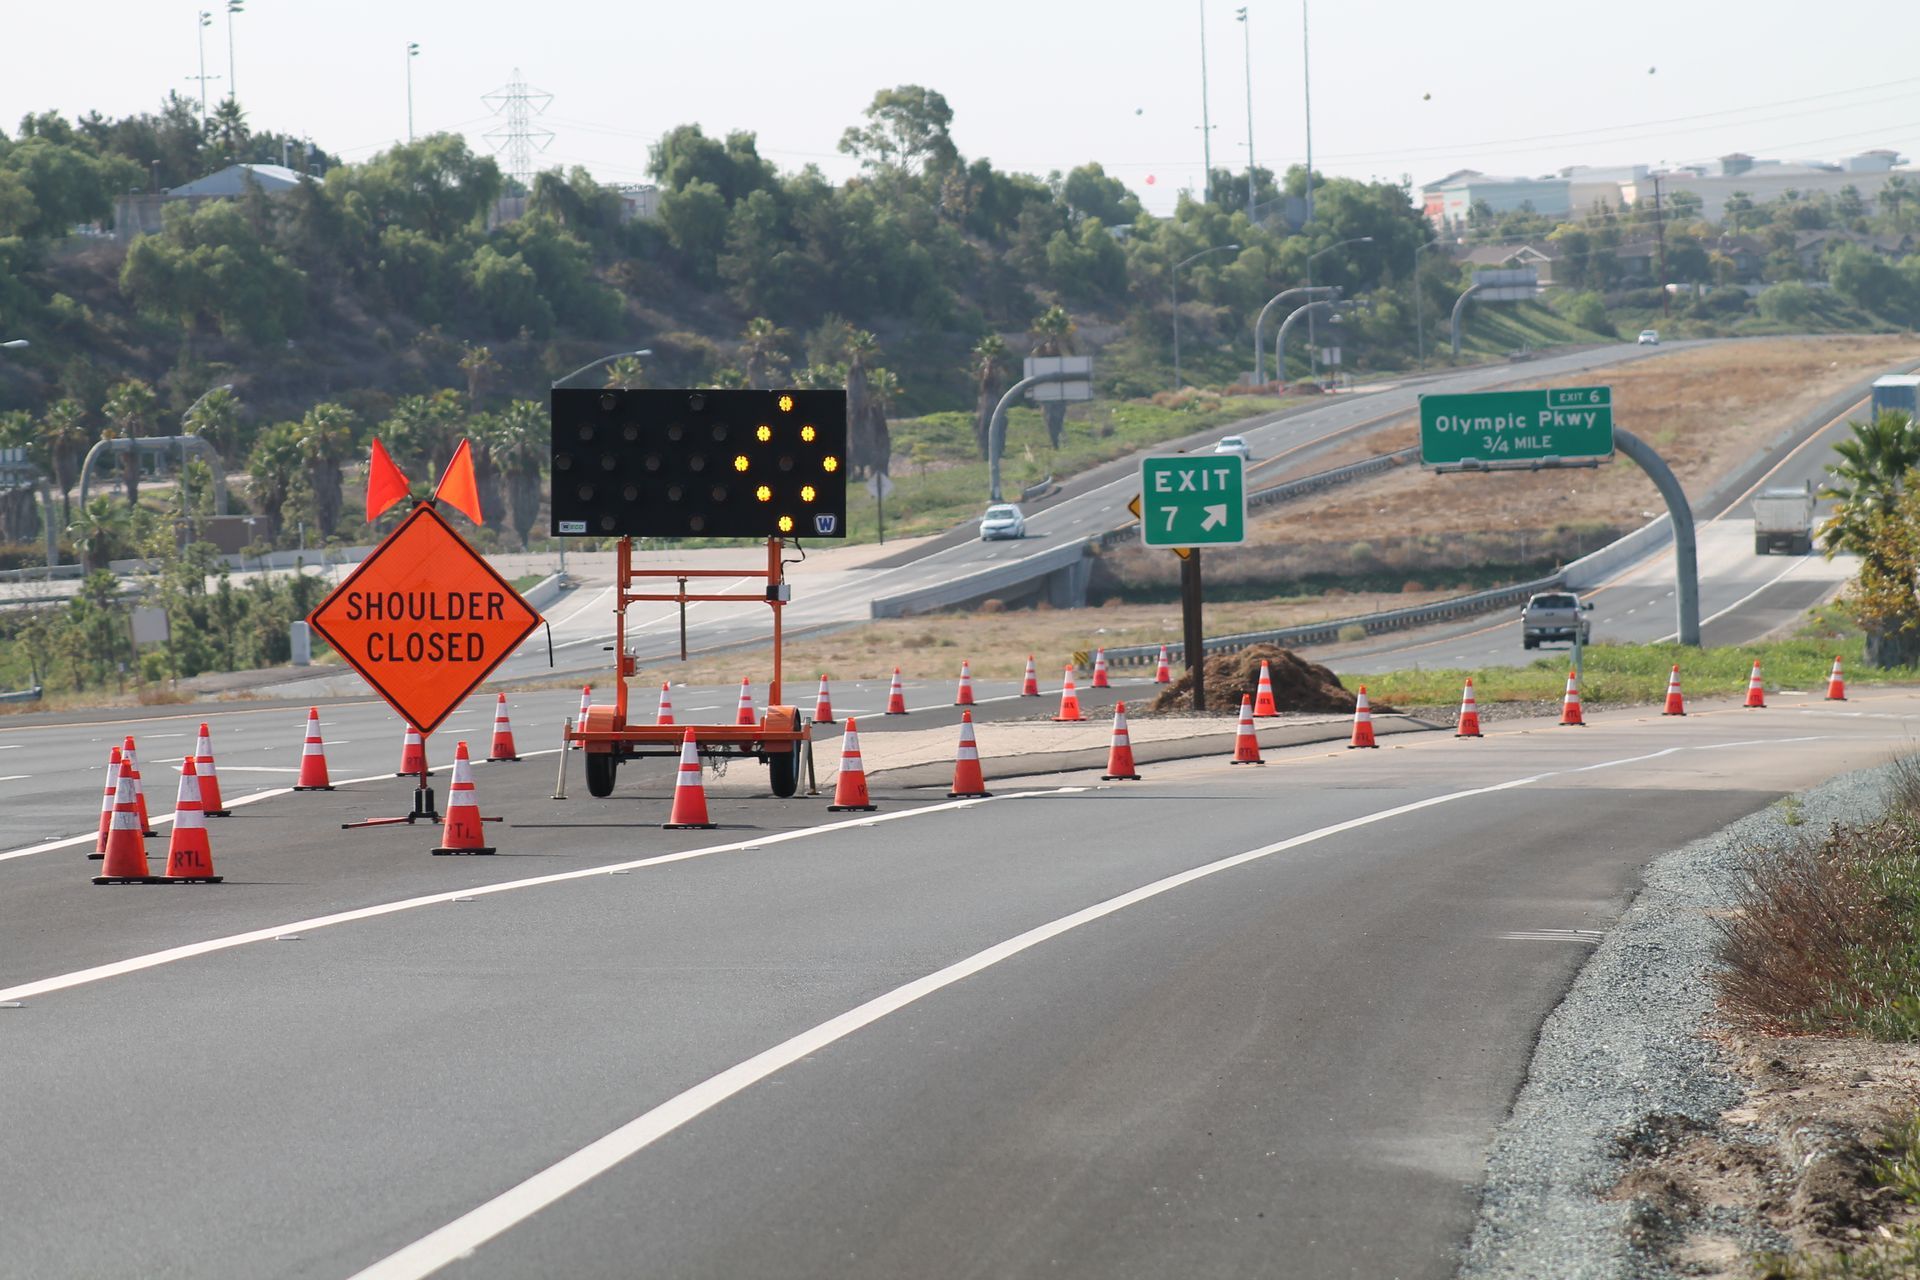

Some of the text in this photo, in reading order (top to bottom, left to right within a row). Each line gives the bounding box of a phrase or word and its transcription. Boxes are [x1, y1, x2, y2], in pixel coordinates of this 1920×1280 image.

[1559, 390, 1600, 403] EXIT 6
[1435, 410, 1597, 435] Olympic Pkwy
[1514, 435, 1552, 449] MILE
[1154, 468, 1230, 493] EXIT
[818, 517, 833, 531] W
[1160, 505, 1179, 532] 7
[346, 592, 505, 621] SHOULDER
[367, 632, 485, 662] CLOSED
[174, 850, 205, 868] RTL
